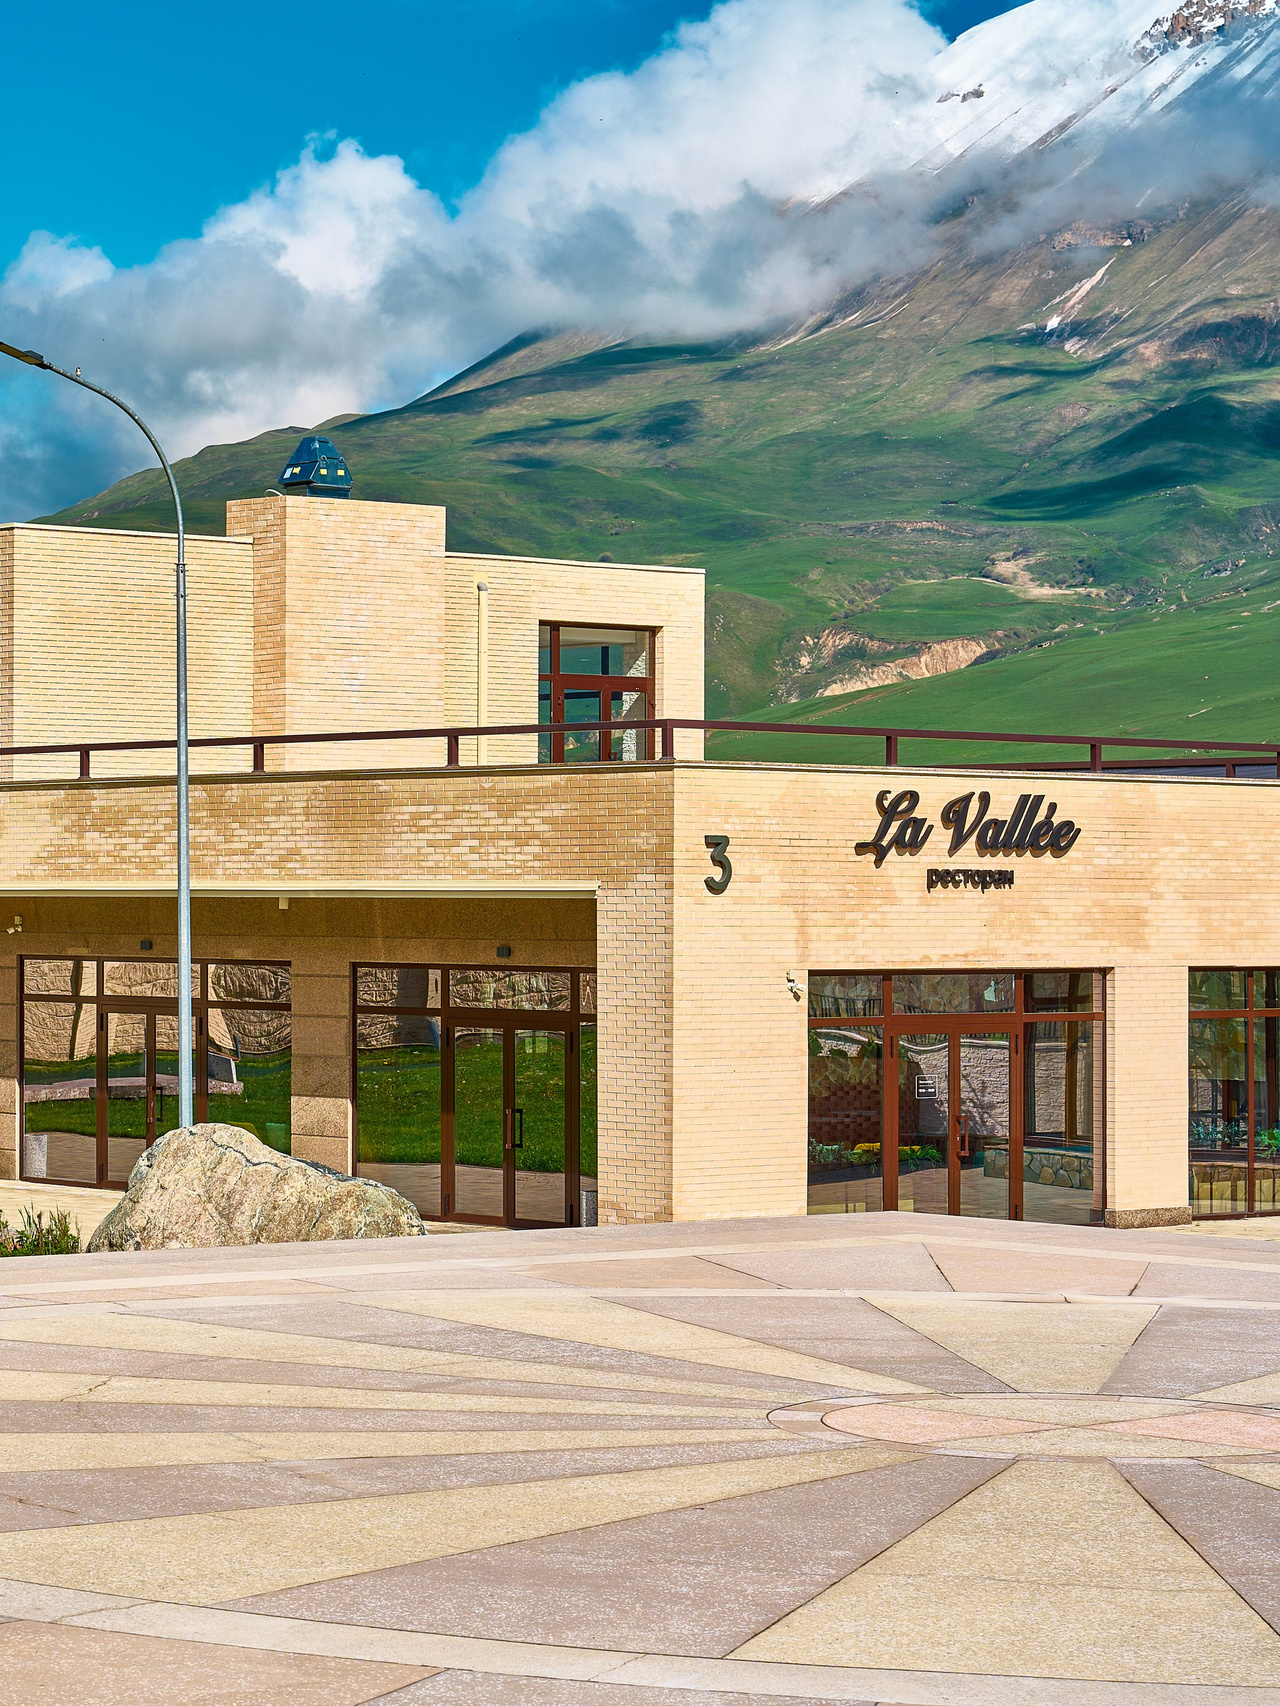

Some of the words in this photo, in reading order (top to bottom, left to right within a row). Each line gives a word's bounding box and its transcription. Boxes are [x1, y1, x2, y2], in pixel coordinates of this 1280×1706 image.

[854, 789, 934, 869] La
[941, 791, 1081, 858] Vallée
[704, 835, 732, 895] 3
[927, 868, 1014, 894] ресторан
